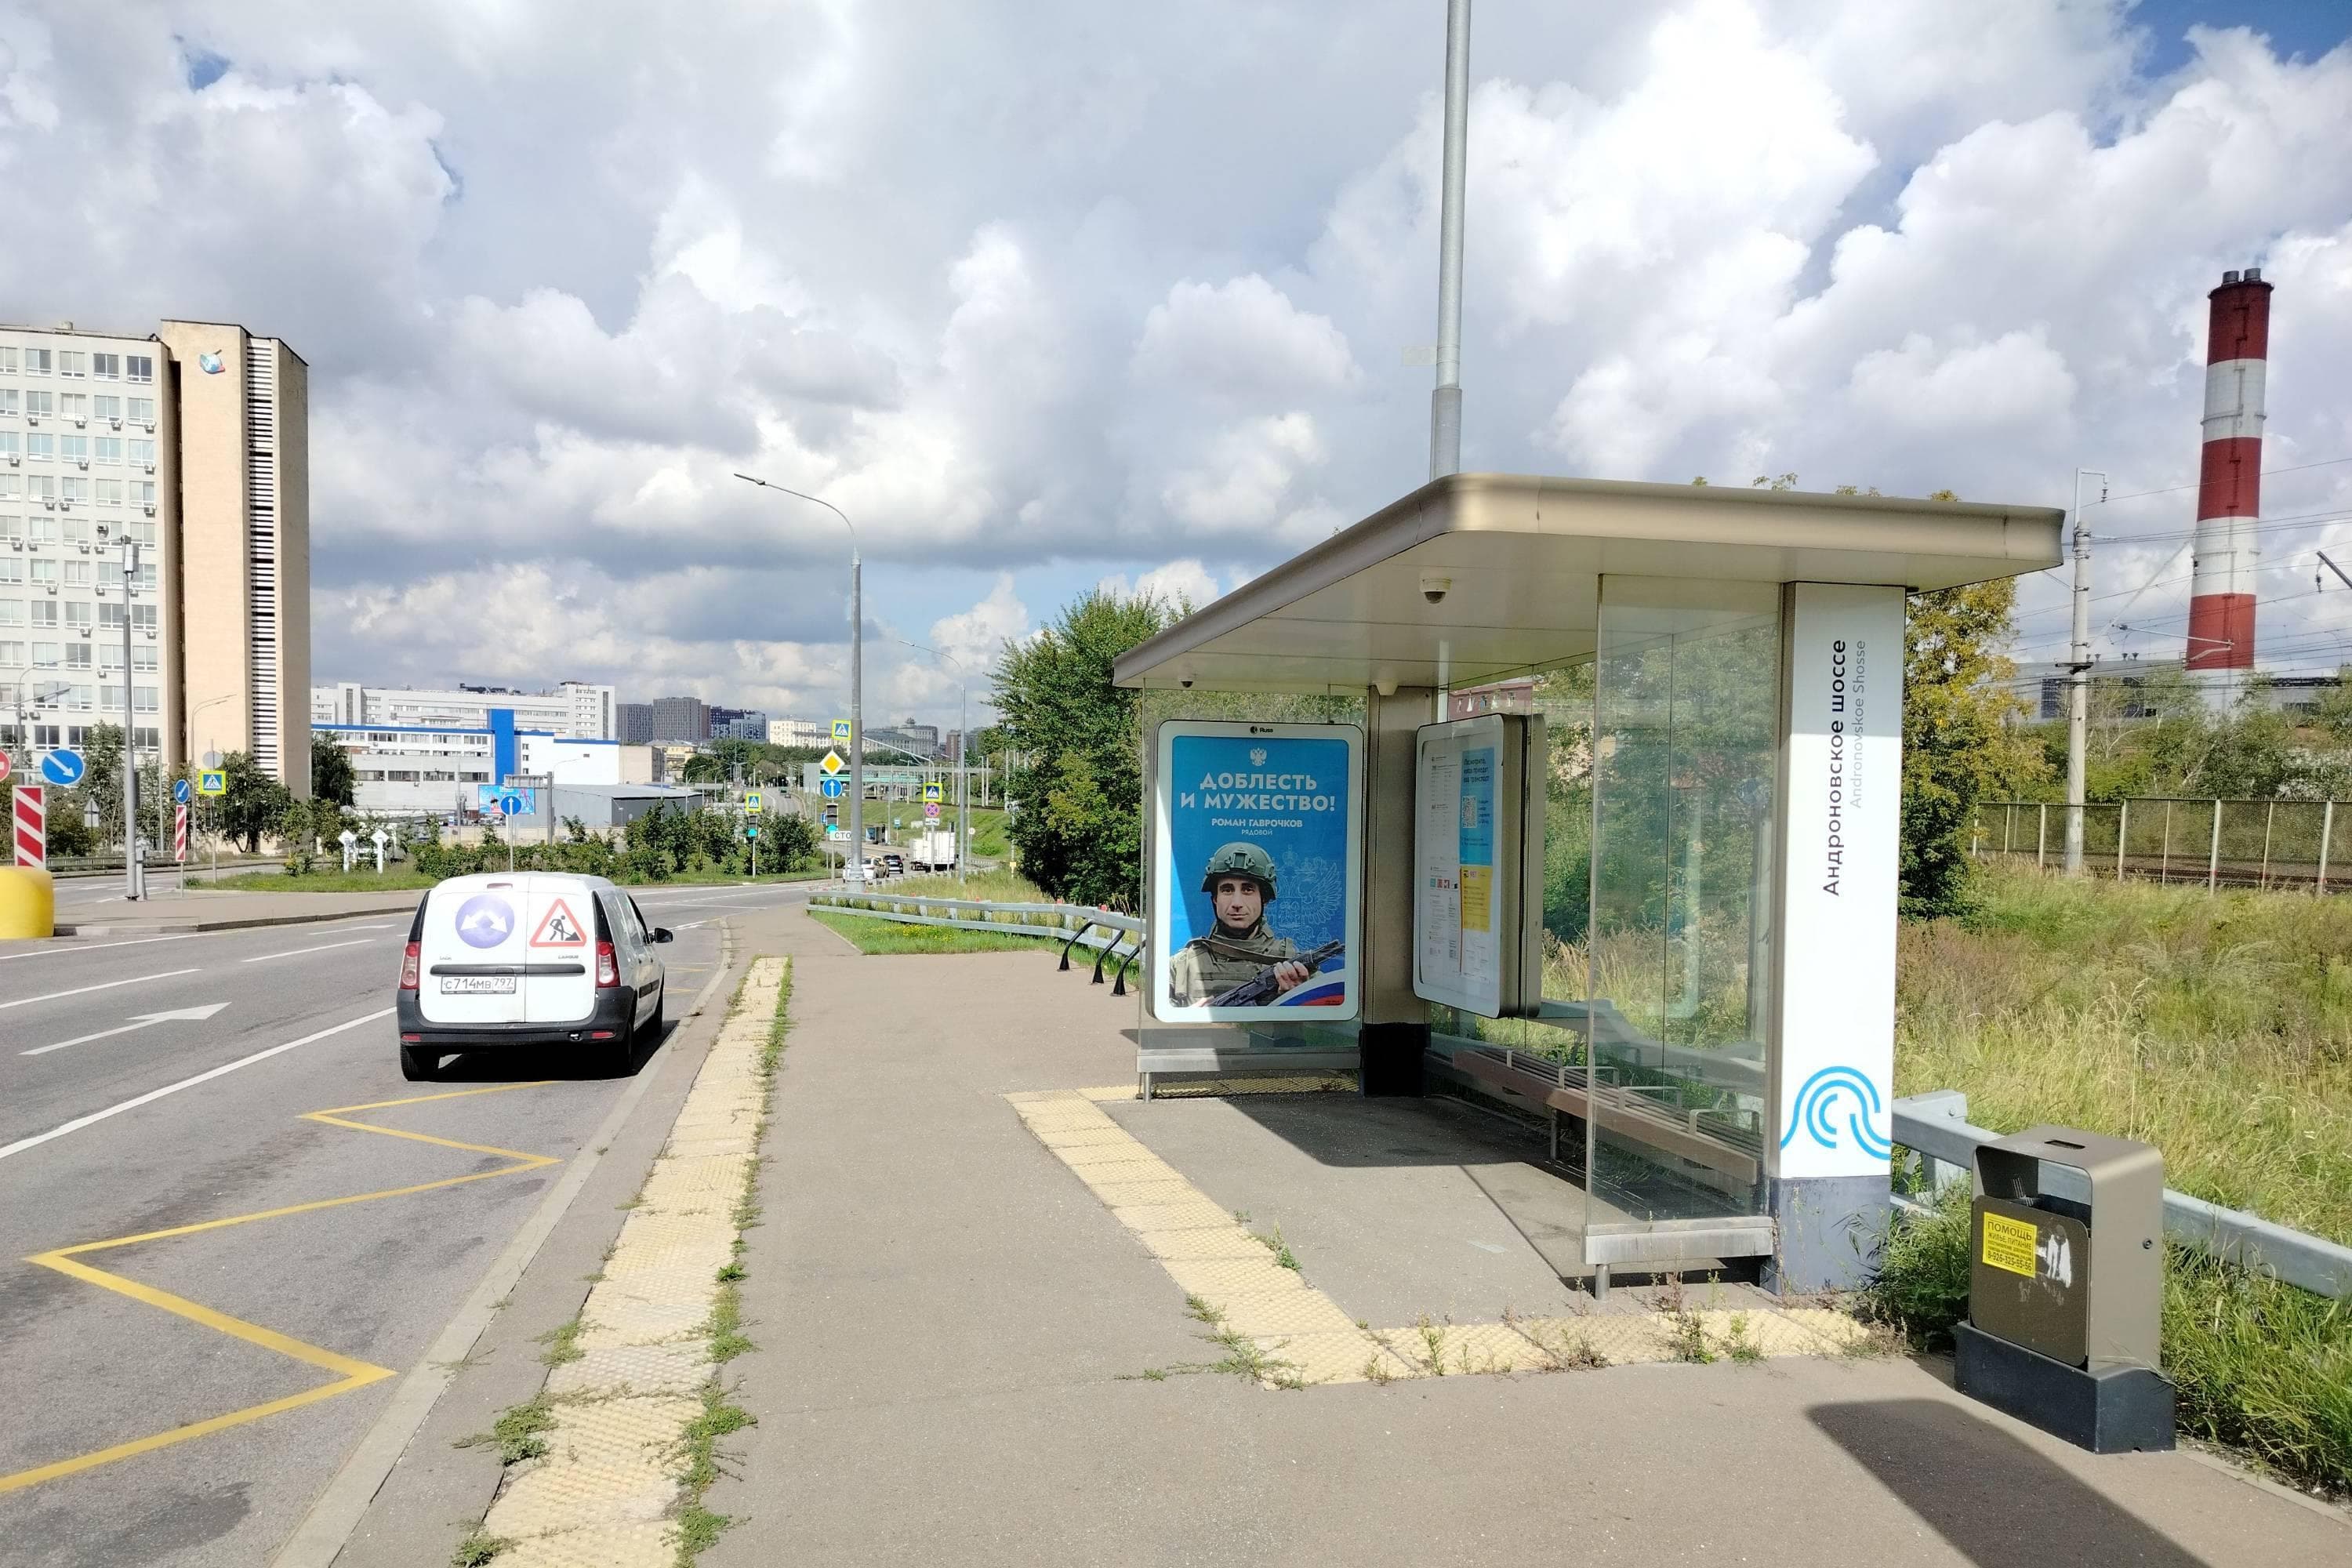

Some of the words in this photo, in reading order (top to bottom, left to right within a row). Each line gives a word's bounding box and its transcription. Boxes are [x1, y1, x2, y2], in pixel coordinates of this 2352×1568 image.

[1831, 640, 1846, 713] шоссе
[1853, 641, 1866, 692] Shosse
[1850, 698, 1864, 809] Andronovskoe
[1200, 772, 1317, 790] ДОБЛЕСТЬ
[1181, 792, 1195, 808] И
[1204, 793, 1335, 811] МУЖЕСТВО!
[1823, 720, 1844, 896] Андроновское
[1211, 818, 1246, 827] РОМАН
[1249, 818, 1303, 828] ГАВРОЧКОВ
[494, 978, 512, 986] 797
[1987, 1221, 2032, 1242] ПОМОЩЬ
[2007, 1236, 2032, 1251] ПИТАНИЕ
